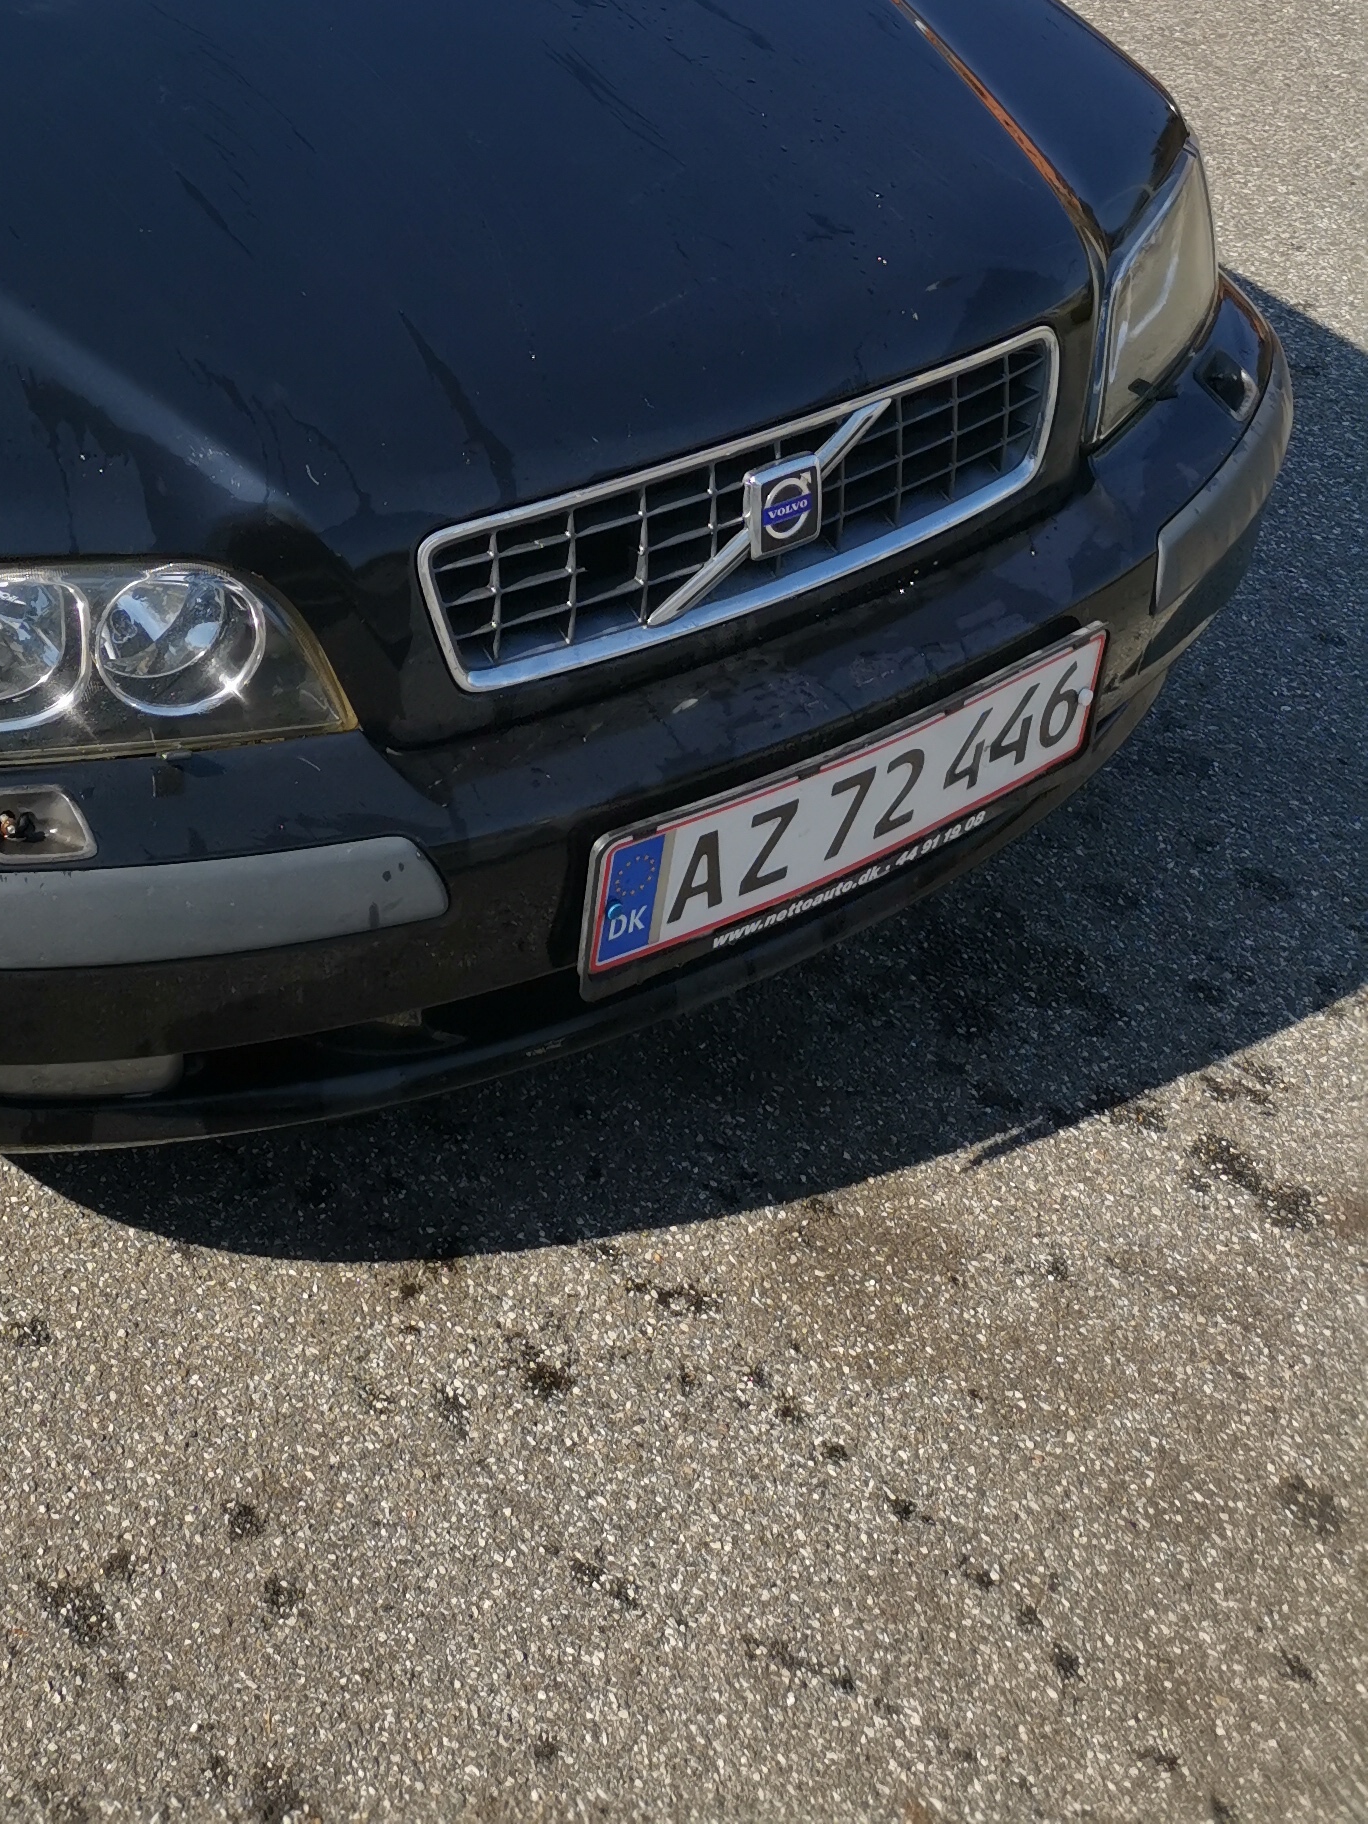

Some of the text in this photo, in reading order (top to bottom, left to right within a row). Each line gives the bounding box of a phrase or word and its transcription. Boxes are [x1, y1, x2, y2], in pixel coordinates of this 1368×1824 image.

[768, 499, 808, 519] VOLVO
[666, 660, 1079, 925] AZ 72 446
[895, 845, 919, 866] 44
[920, 833, 941, 854] 91
[943, 823, 962, 843] 19
[964, 810, 986, 832] 08
[608, 905, 648, 941] DK
